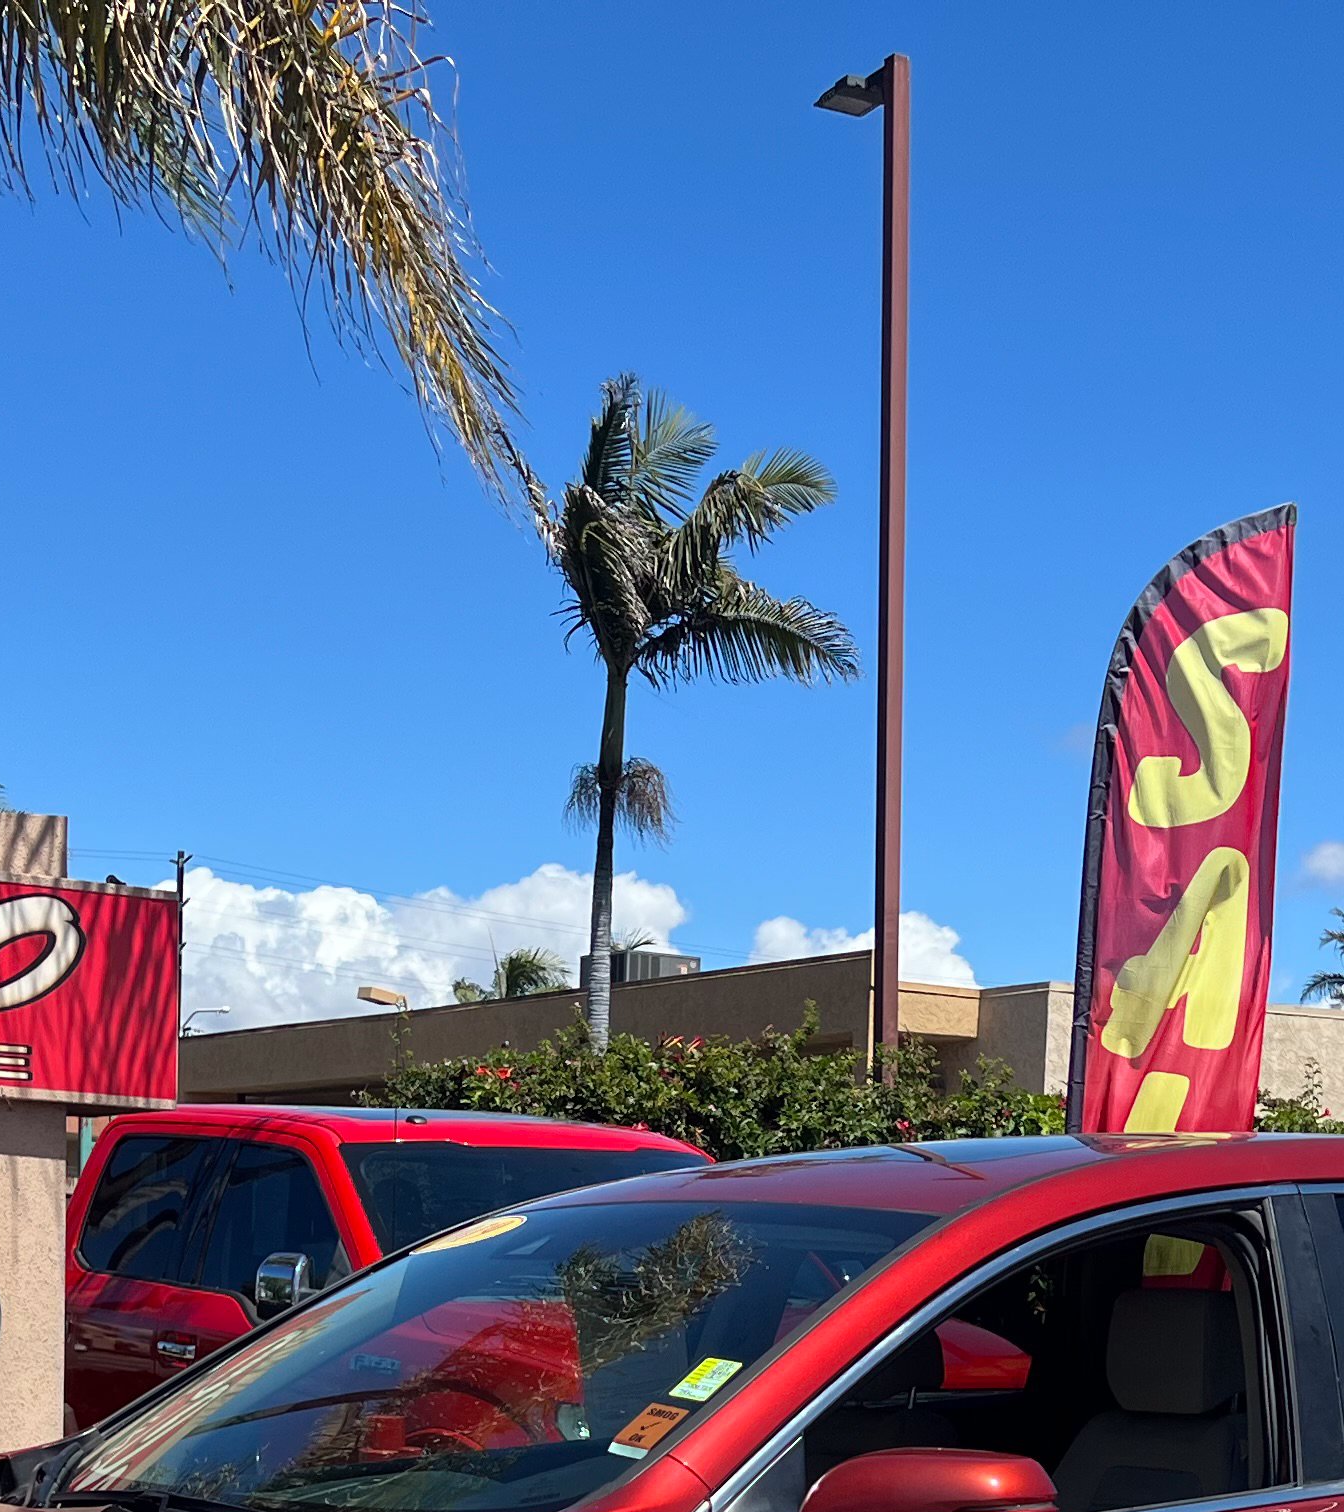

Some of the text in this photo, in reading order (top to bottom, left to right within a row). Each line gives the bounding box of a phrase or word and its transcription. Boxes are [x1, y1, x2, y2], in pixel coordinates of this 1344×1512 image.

[1101, 606, 1289, 1132] SA
[646, 1407, 680, 1421] SMOG
[628, 1432, 647, 1443] OK
